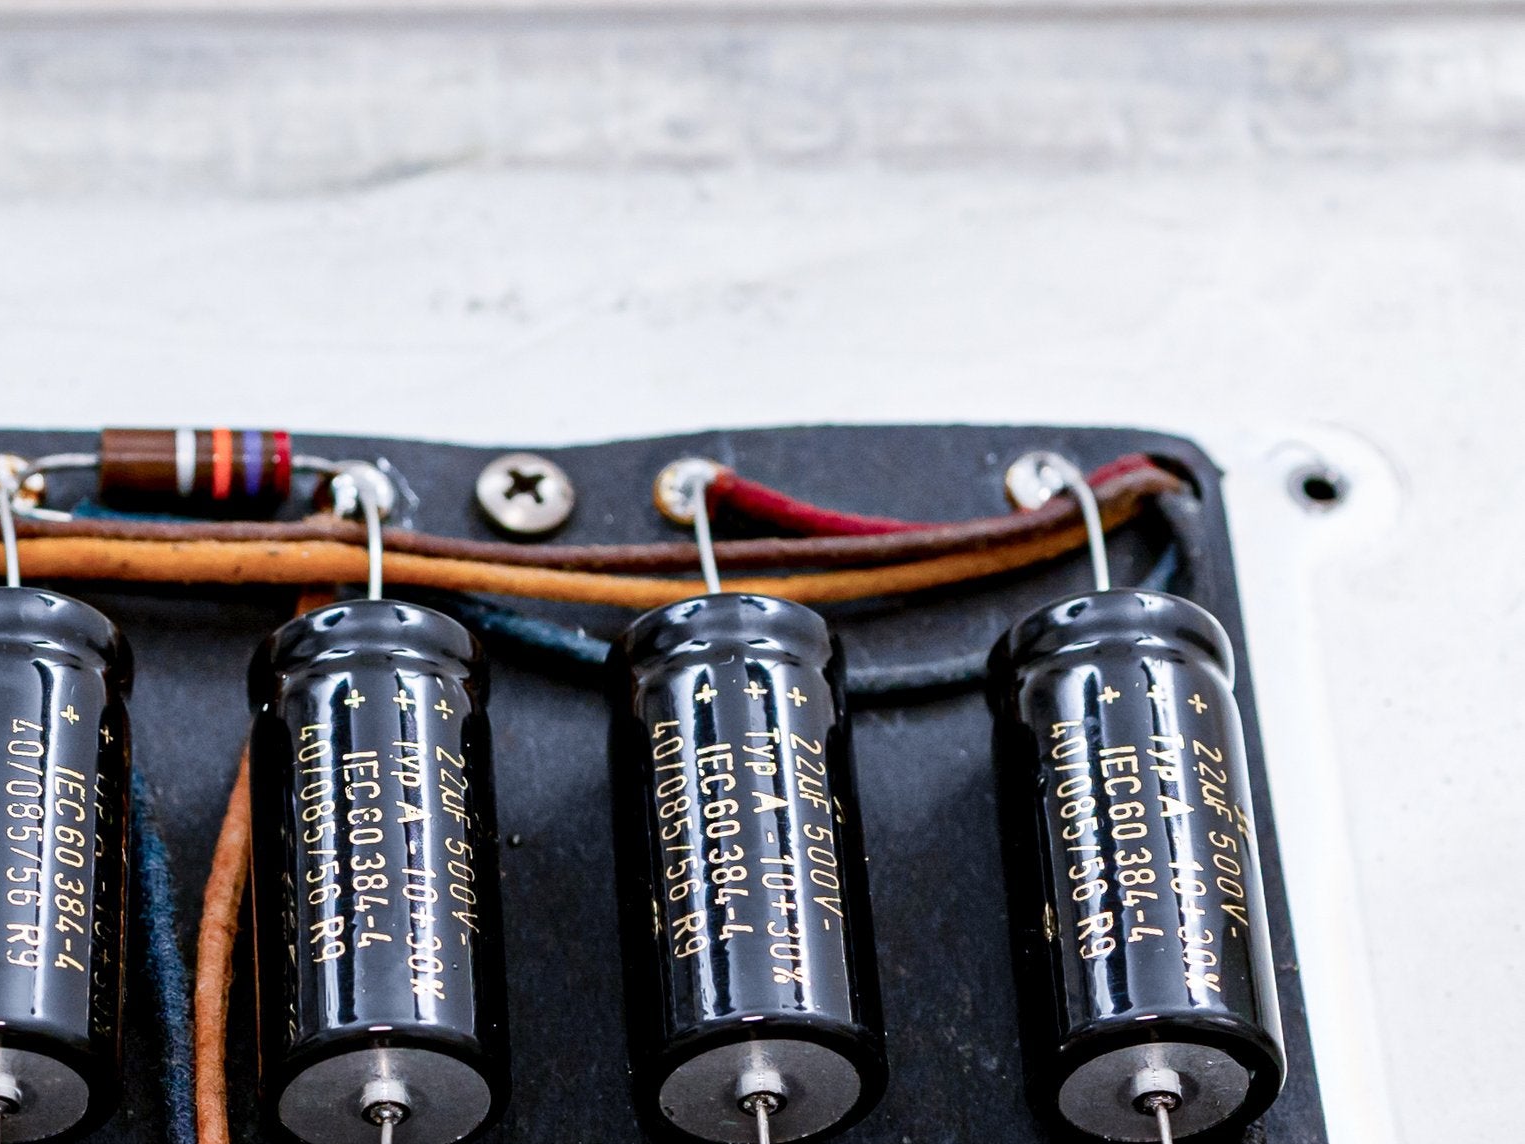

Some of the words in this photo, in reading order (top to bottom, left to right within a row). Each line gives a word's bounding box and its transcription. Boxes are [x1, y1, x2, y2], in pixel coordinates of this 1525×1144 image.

[390, 740, 425, 787] Typ
[743, 727, 783, 775] Typ
[1146, 734, 1186, 781] Typ
[6, 718, 44, 906] 40/085/56
[297, 723, 342, 904] 40/085/56
[397, 801, 432, 824] A
[652, 721, 700, 901] 40/085/56
[752, 791, 788, 813] A
[1051, 721, 1107, 901] 40/085/56
[1158, 795, 1194, 817] A
[6, 923, 46, 969] R9
[309, 918, 345, 962] R9
[672, 910, 709, 958] R9
[1077, 912, 1116, 960] R9
